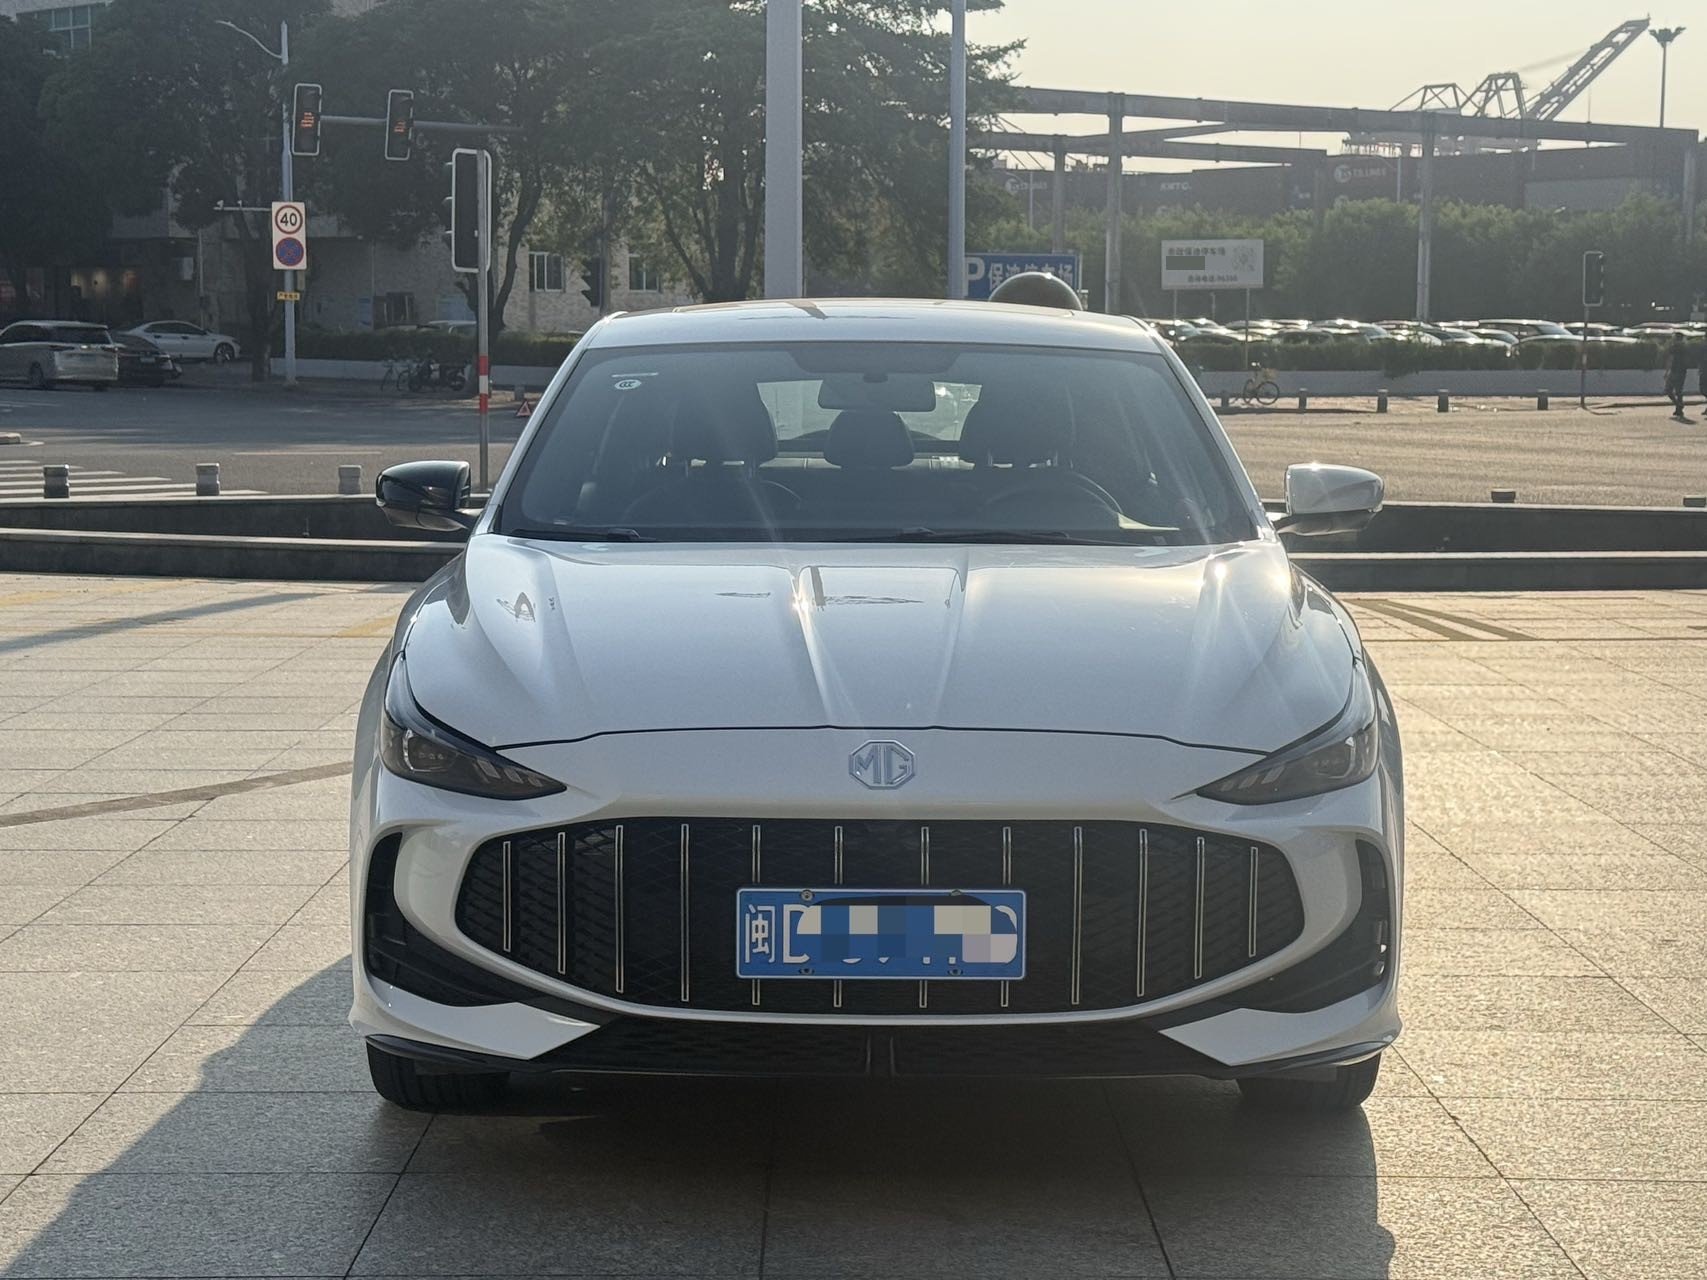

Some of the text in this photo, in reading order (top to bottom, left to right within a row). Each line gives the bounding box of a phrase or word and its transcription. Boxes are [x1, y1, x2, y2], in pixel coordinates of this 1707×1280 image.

[280, 212, 297, 226] 40
[963, 257, 985, 297] P
[854, 744, 910, 785] MG
